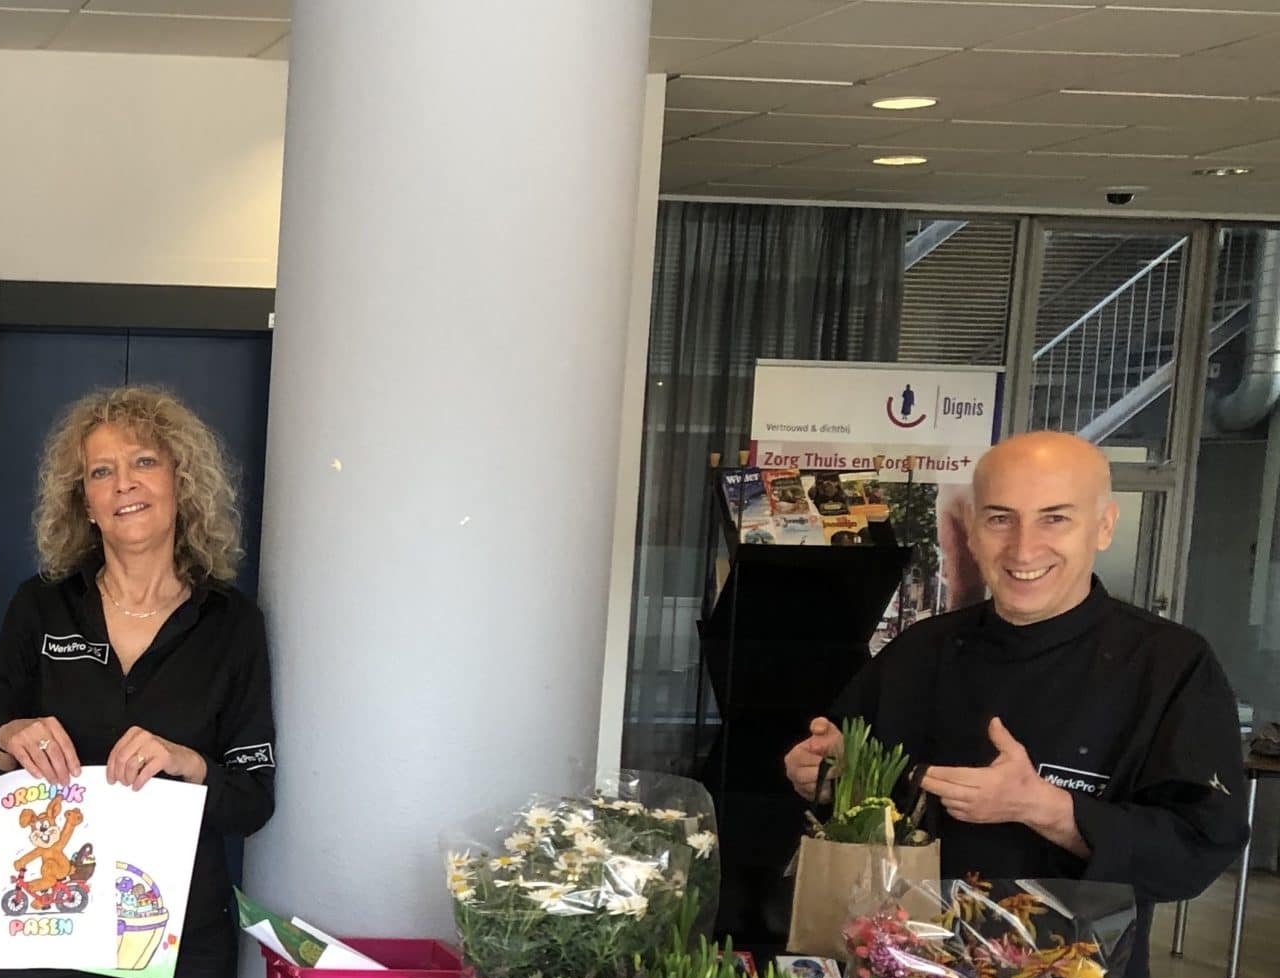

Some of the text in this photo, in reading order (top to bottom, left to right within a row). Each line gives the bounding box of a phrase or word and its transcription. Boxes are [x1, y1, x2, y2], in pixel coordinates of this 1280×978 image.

[942, 396, 984, 419] Dignis
[766, 423, 851, 435] Vertrouwd & dichtbij
[764, 451, 799, 468] Zorg
[804, 452, 847, 468] Thuis
[852, 456, 870, 468] en
[48, 641, 86, 653] WerkPro
[9, 917, 73, 937] PASEN
